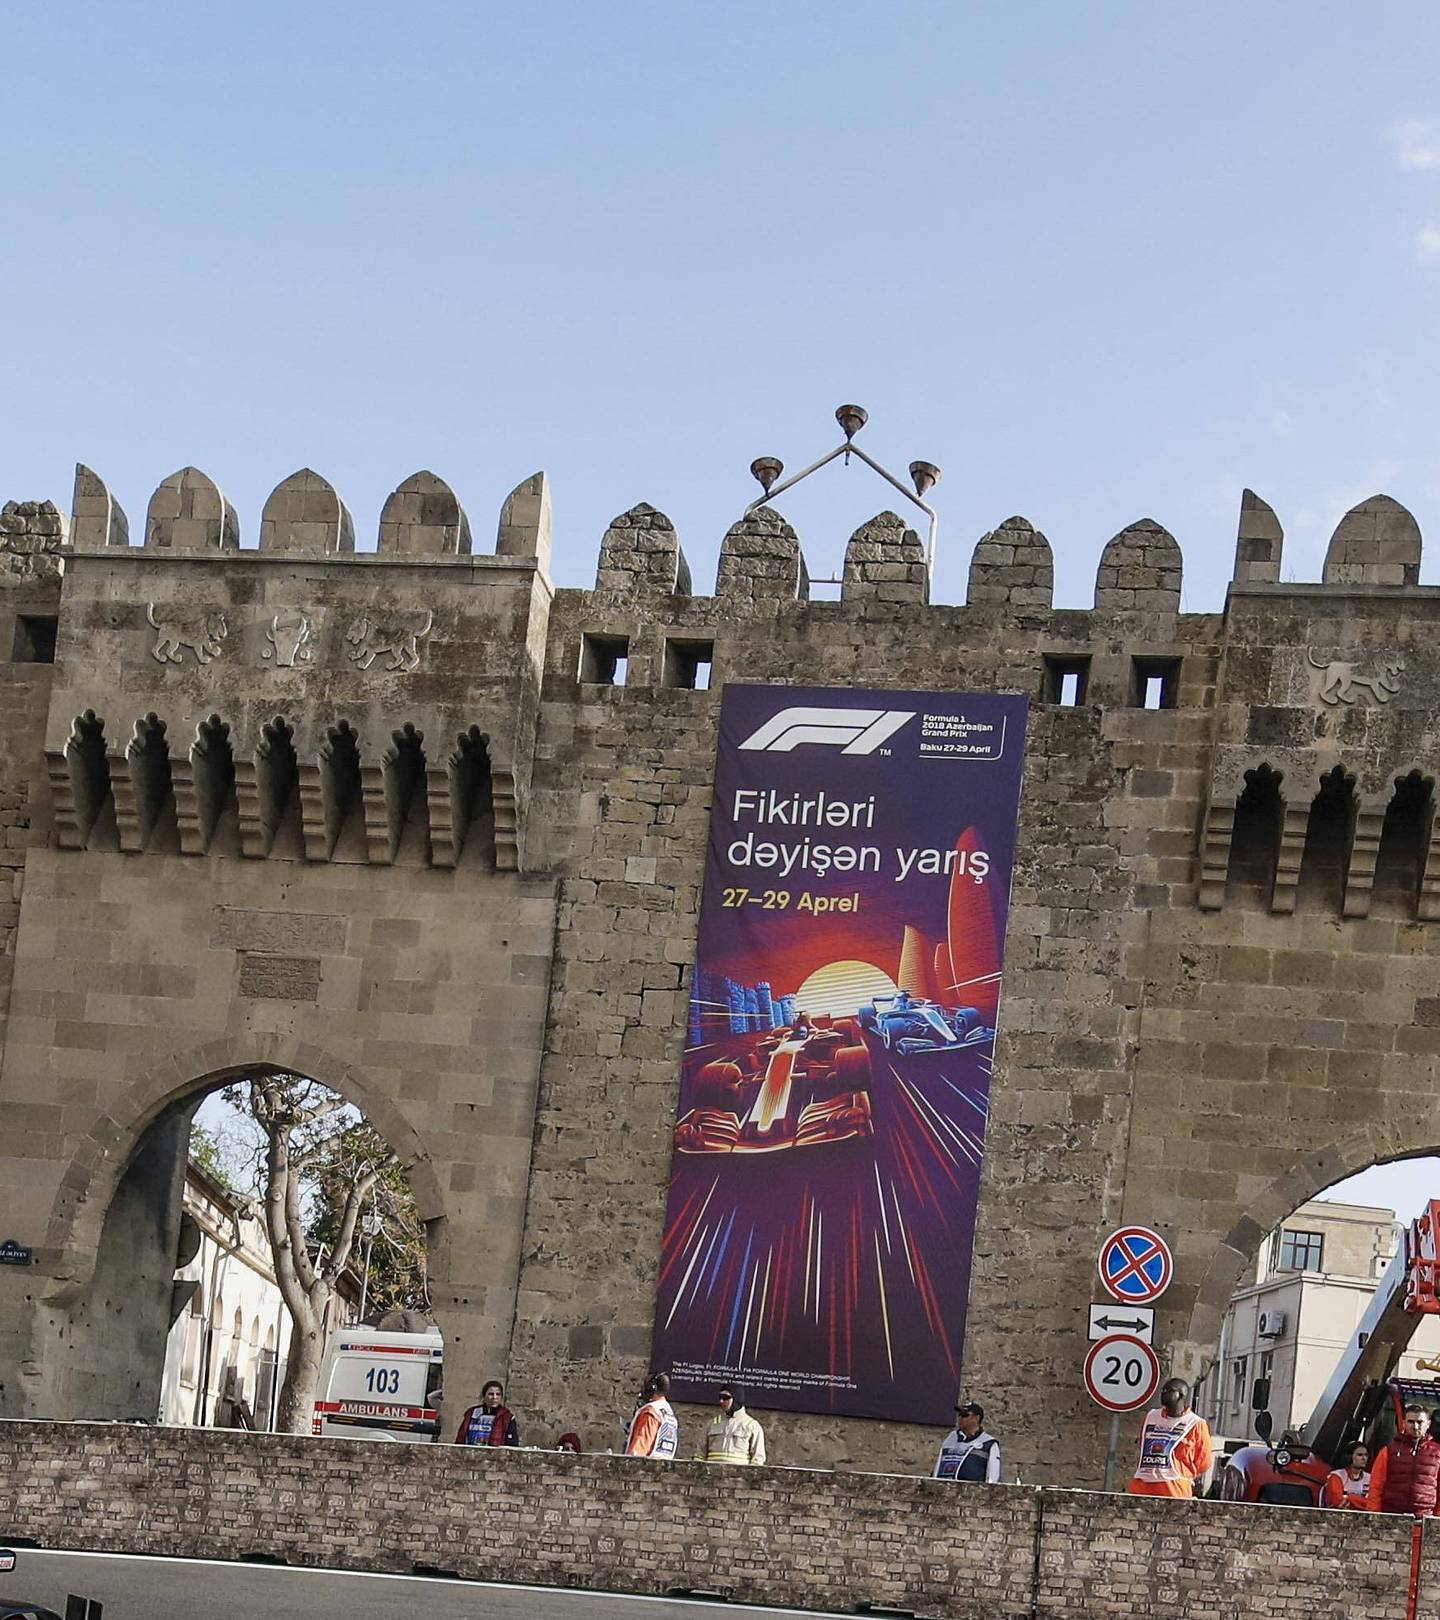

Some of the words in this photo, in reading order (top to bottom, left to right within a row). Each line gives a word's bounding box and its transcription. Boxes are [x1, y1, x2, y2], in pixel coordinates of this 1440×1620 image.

[922, 721, 945, 730] 2018
[945, 722, 993, 732] Azerbaijan
[923, 714, 959, 723] Formula
[960, 715, 966, 723] 1
[921, 729, 949, 737] Grand
[949, 729, 968, 738] Prix
[920, 743, 943, 752] Baku
[943, 744, 968, 753] 27-29
[969, 745, 991, 754] April
[733, 789, 875, 828] Fikirləri
[727, 832, 880, 878] dəyişən
[895, 846, 991, 884] yarış
[796, 891, 860, 916] Aprel
[366, 1367, 400, 1394] 103
[1102, 1355, 1143, 1387] 20
[339, 1402, 409, 1418] AMBULANS
